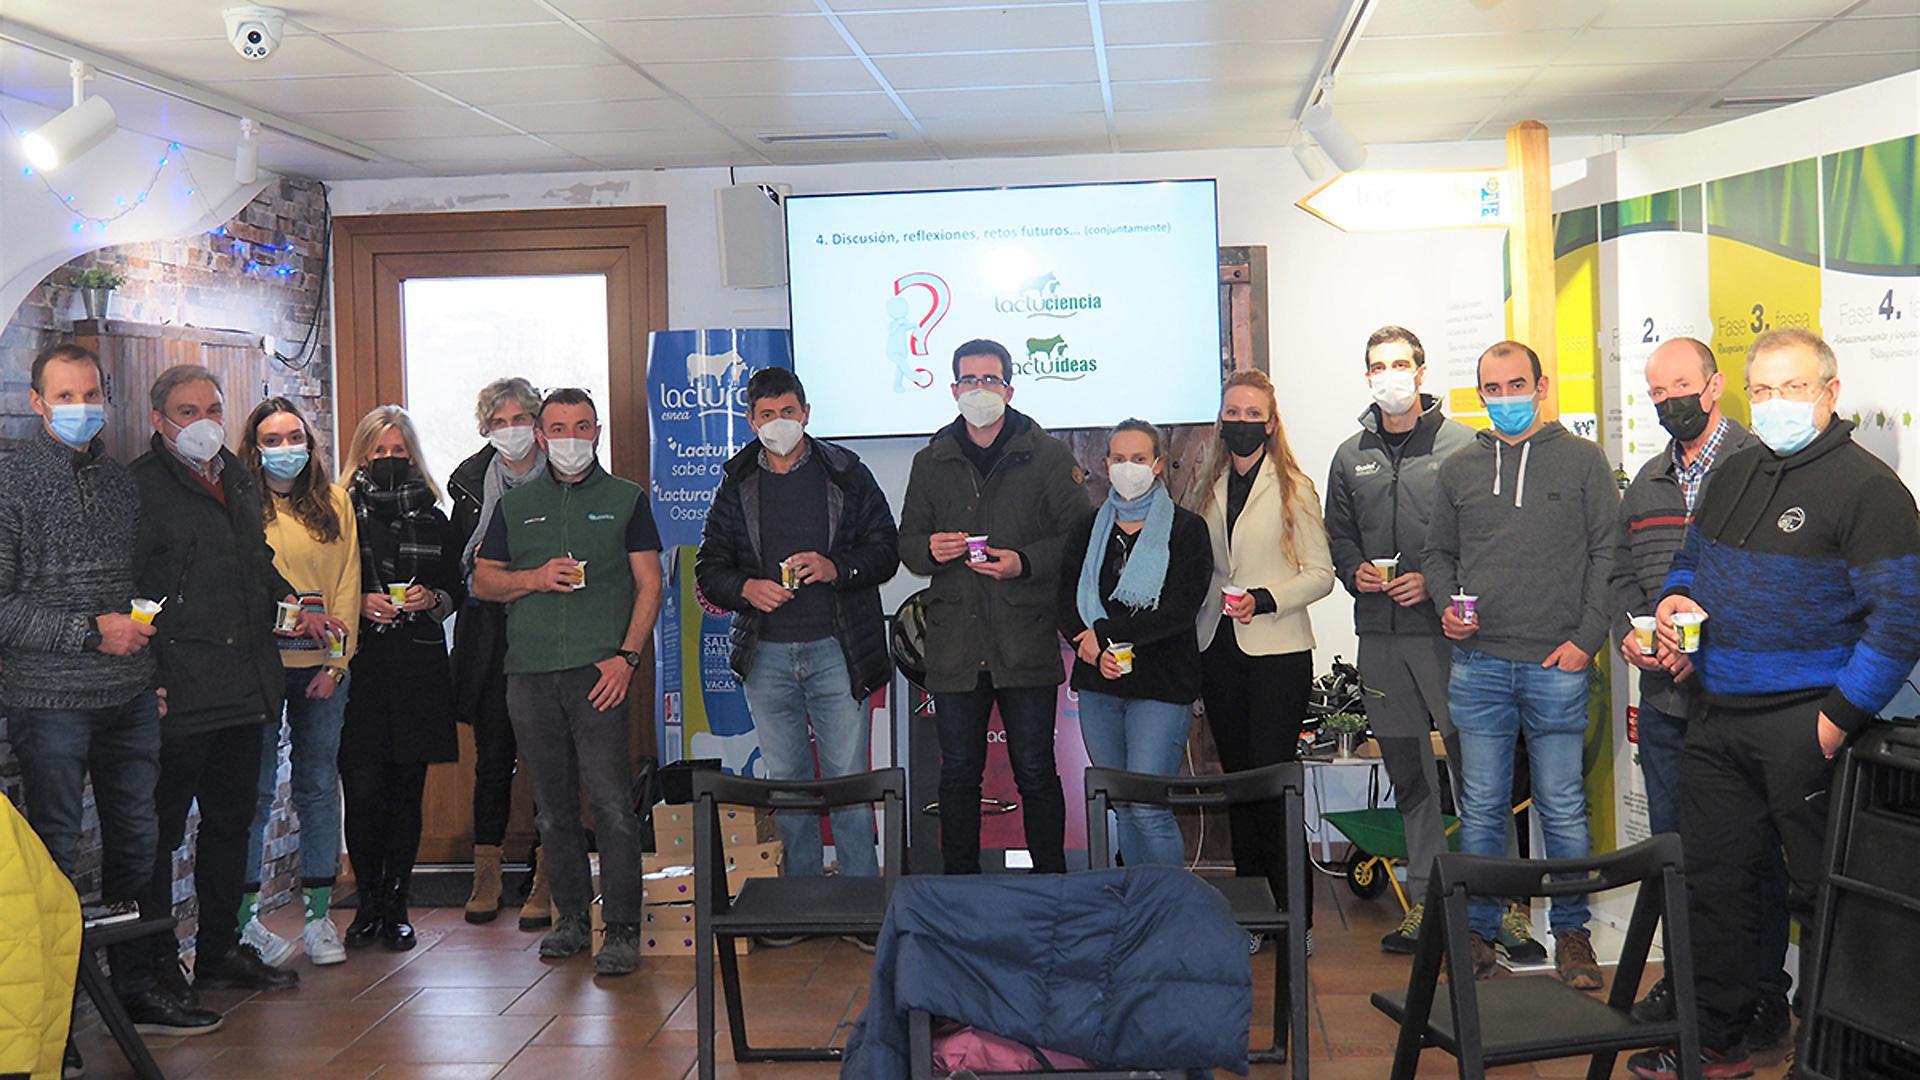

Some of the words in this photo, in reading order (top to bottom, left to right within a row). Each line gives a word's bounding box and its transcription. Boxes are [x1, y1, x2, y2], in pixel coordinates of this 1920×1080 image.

[815, 234, 828, 245] 4.
[832, 231, 899, 245] Discusión,
[903, 228, 980, 242] reflexiones,
[983, 227, 1018, 239] retos
[1084, 222, 1172, 237] (conjuntamente)
[1642, 316, 1660, 343] 2.
[1718, 315, 1747, 337] Fase
[1750, 303, 1770, 334] 3.
[1011, 357, 1098, 376] actuideas
[671, 462, 706, 476] sabe
[709, 464, 721, 475] a
[705, 680, 736, 689] VACAS
